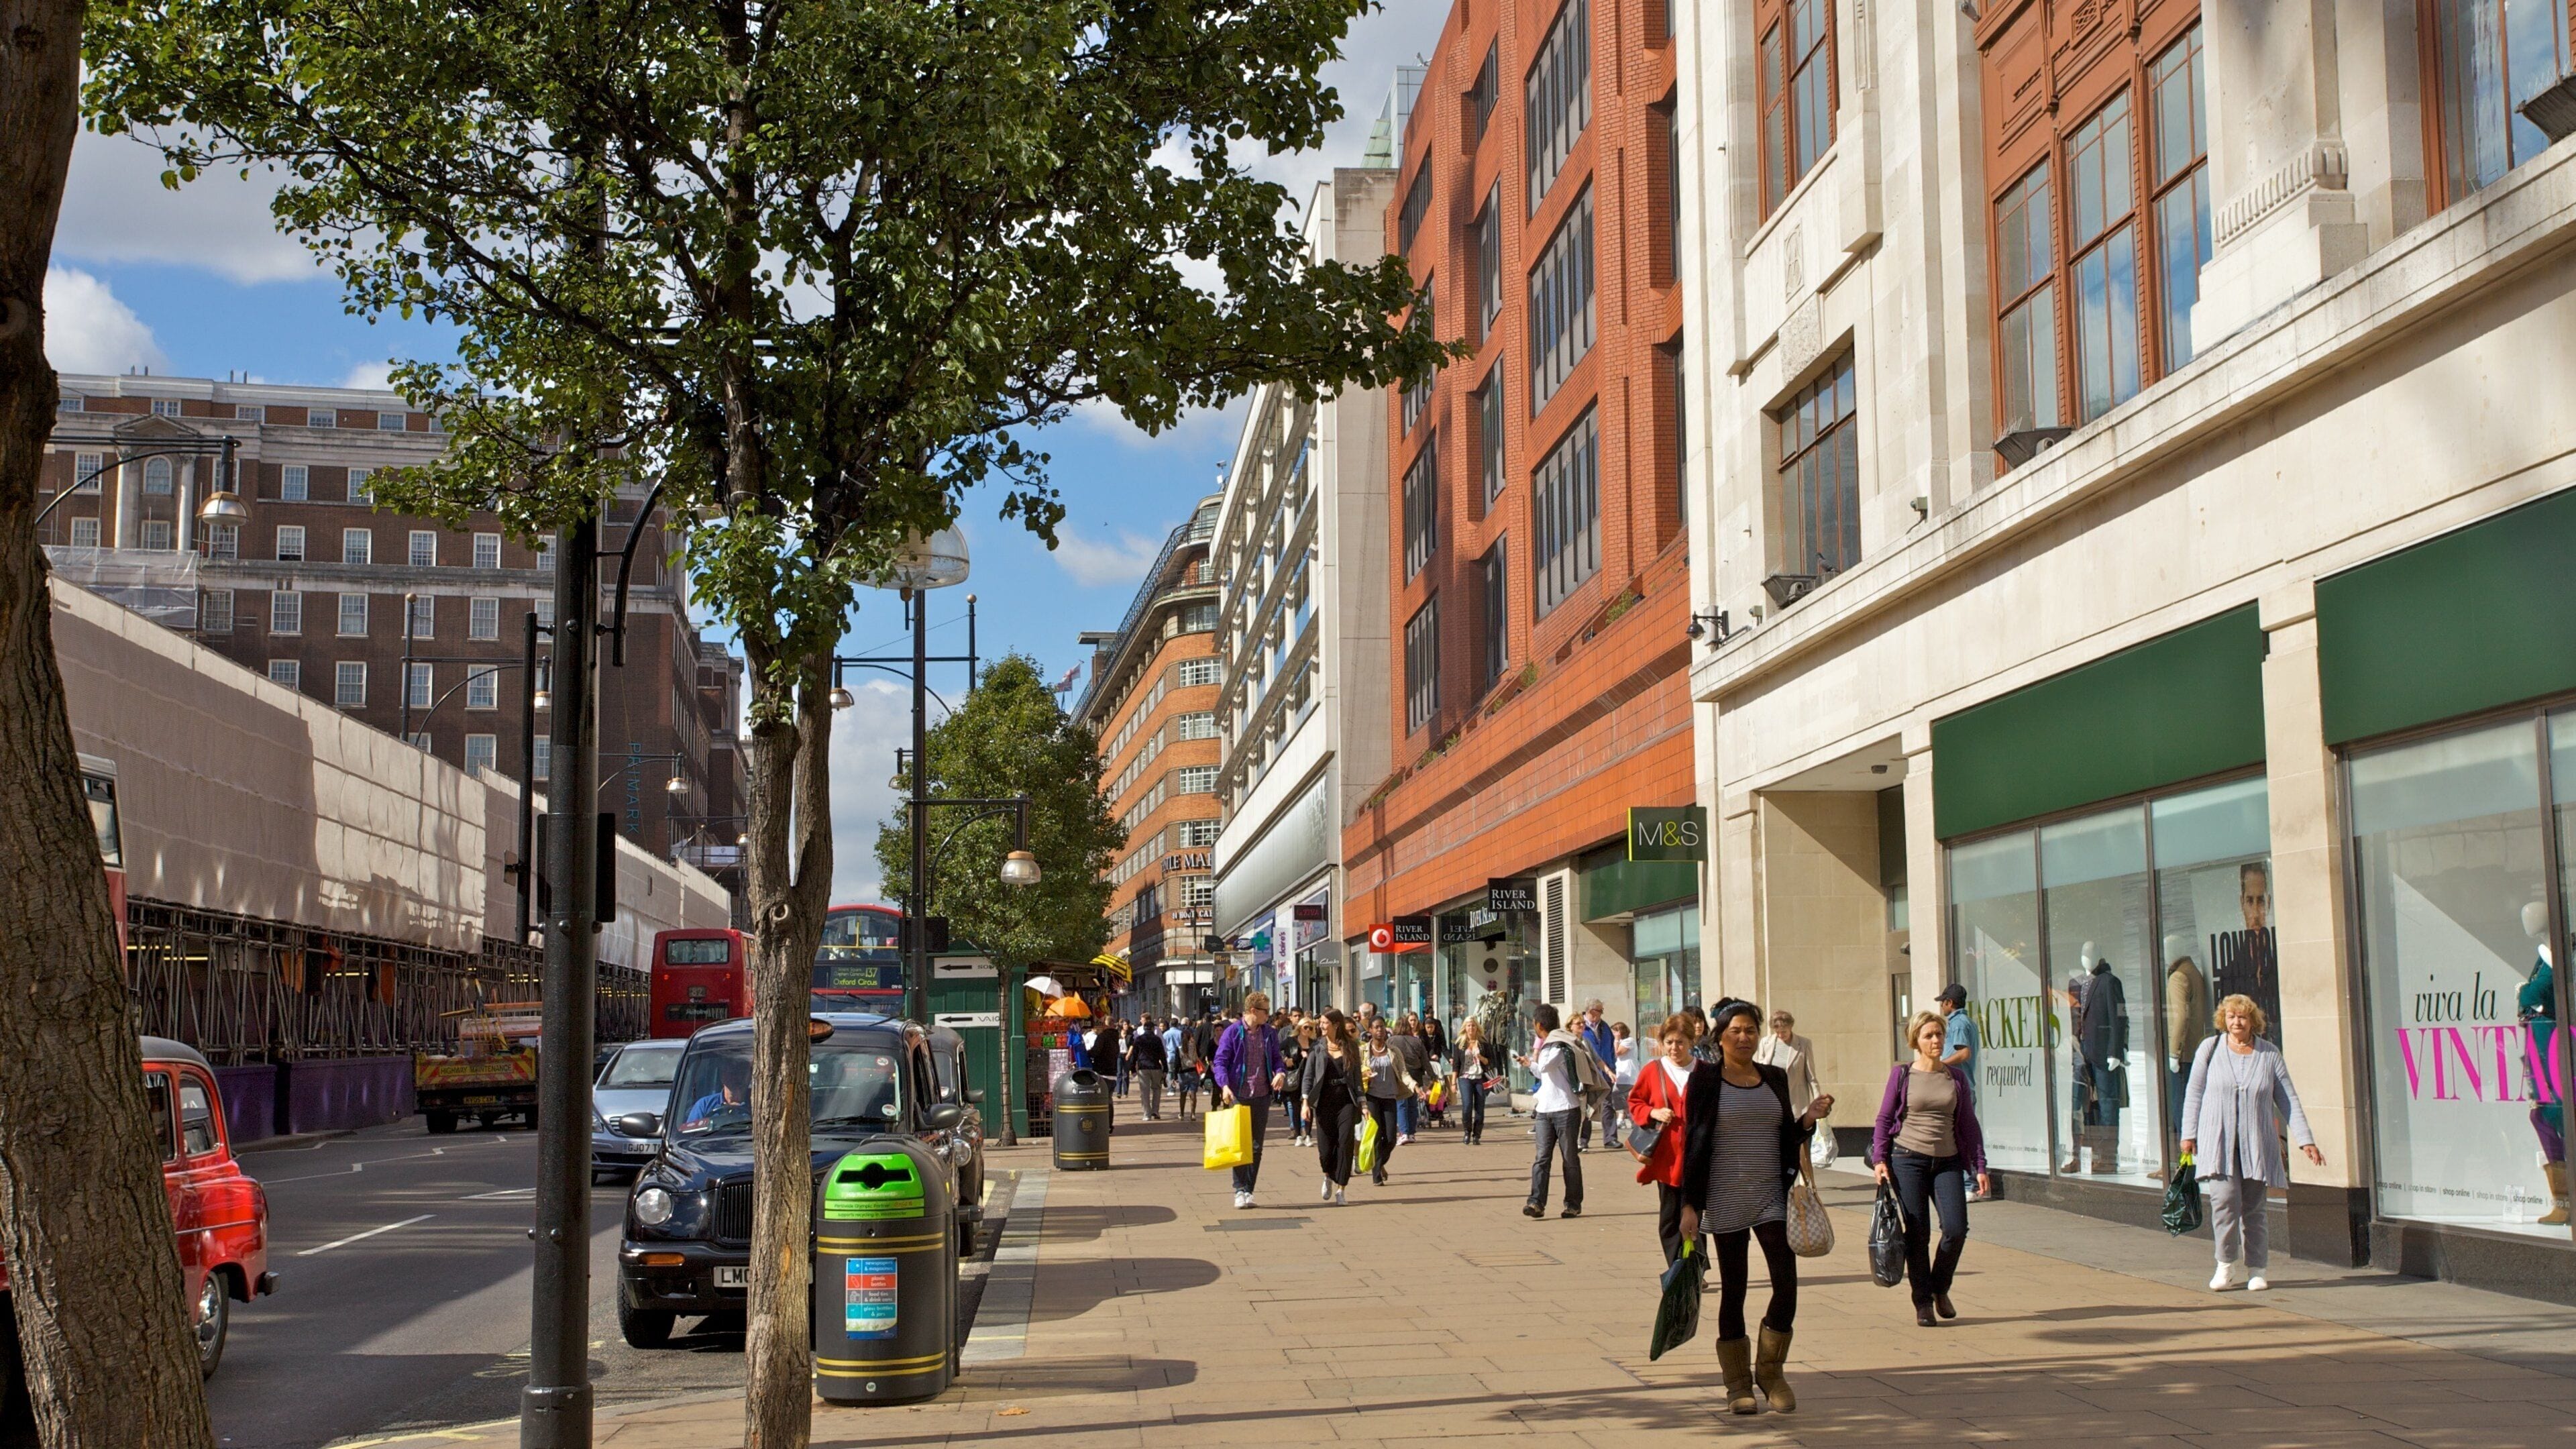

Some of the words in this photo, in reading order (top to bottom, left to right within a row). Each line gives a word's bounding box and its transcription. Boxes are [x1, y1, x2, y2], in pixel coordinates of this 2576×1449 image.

[627, 743, 641, 834] PRIMARK
[1639, 822, 1699, 846] M&S
[1491, 890, 1526, 898] RIVER
[1492, 900, 1536, 910] ISLAND
[1395, 933, 1430, 941] ISLAND
[865, 967, 877, 977] 137
[692, 987, 703, 996] 82
[2415, 974, 2463, 1022] viva
[2473, 971, 2498, 1020] la
[440, 1066, 468, 1074] HIGHWAY
[470, 1063, 512, 1073] MAINTENANCE
[1986, 1053, 2032, 1097] required
[628, 1143, 649, 1152] GJ07
[2377, 1181, 2388, 1189] shop
[2389, 1181, 2402, 1190] online
[2443, 1187, 2455, 1197] shop
[2455, 1189, 2471, 1197] online
[2477, 1191, 2489, 1201] shop
[2495, 1193, 2508, 1201] store
[2513, 1194, 2526, 1203] shop
[2526, 1195, 2543, 1205] online
